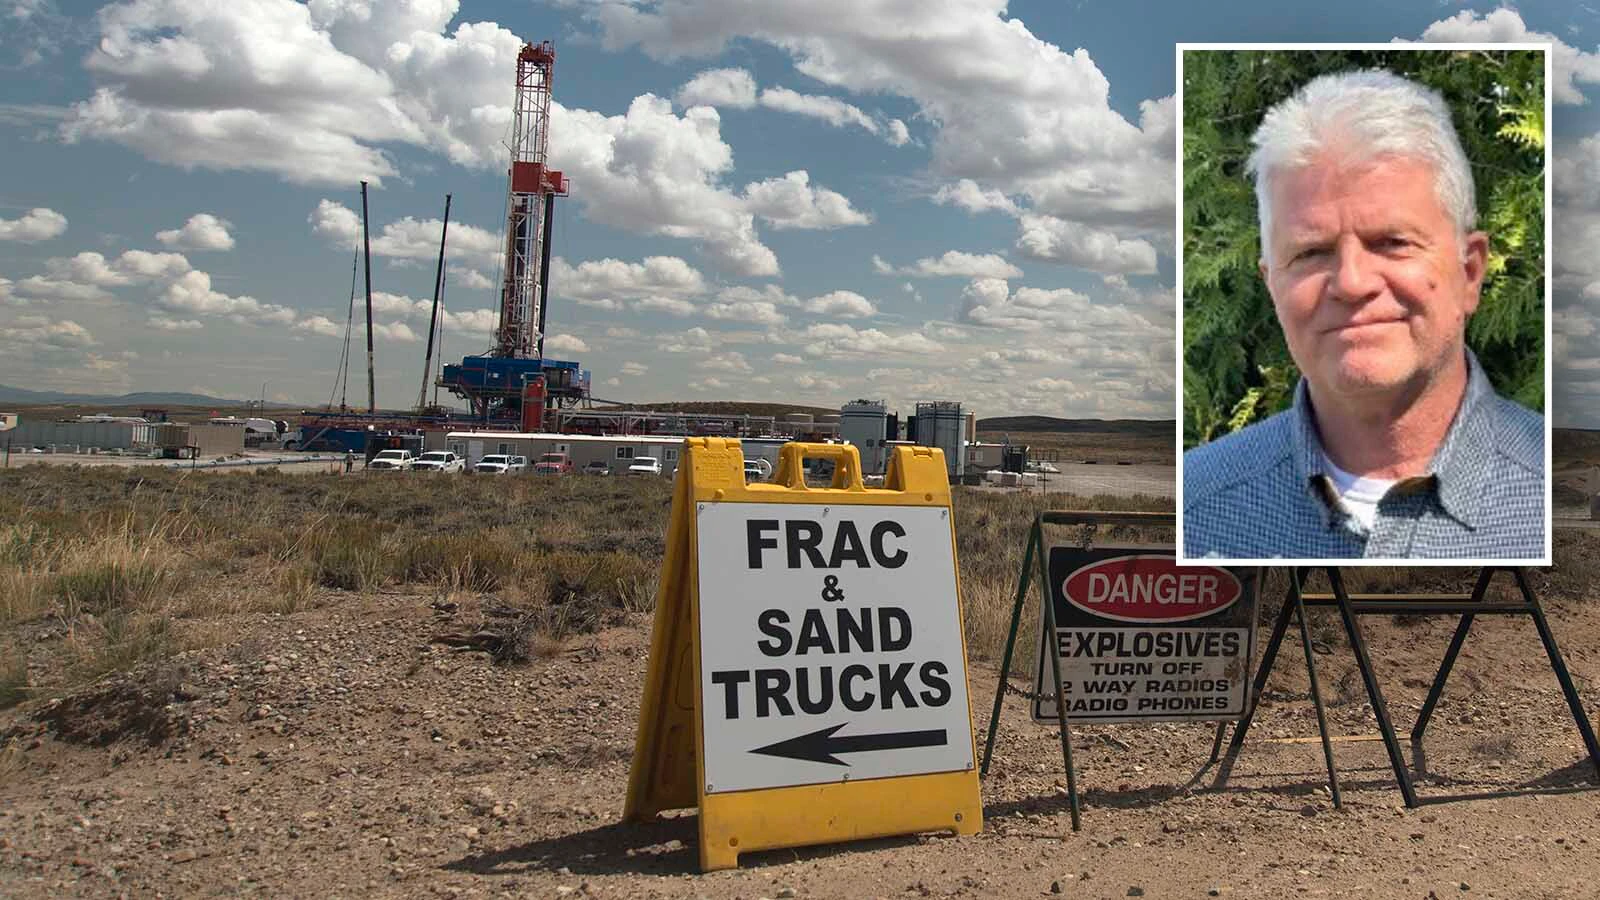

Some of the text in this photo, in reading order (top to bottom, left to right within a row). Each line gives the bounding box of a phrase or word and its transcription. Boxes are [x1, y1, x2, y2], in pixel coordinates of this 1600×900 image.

[746, 519, 908, 569] FRAC
[821, 574, 845, 602] &
[1087, 573, 1218, 604] DANGER
[757, 607, 912, 656] SAND
[1056, 631, 1240, 657] EXPLOSIVES
[1091, 662, 1203, 676] TURN OFF
[711, 661, 952, 720] TRUCKS
[1062, 679, 1229, 694] 2 WAY RADIOS
[1138, 697, 1229, 711] PHONES
